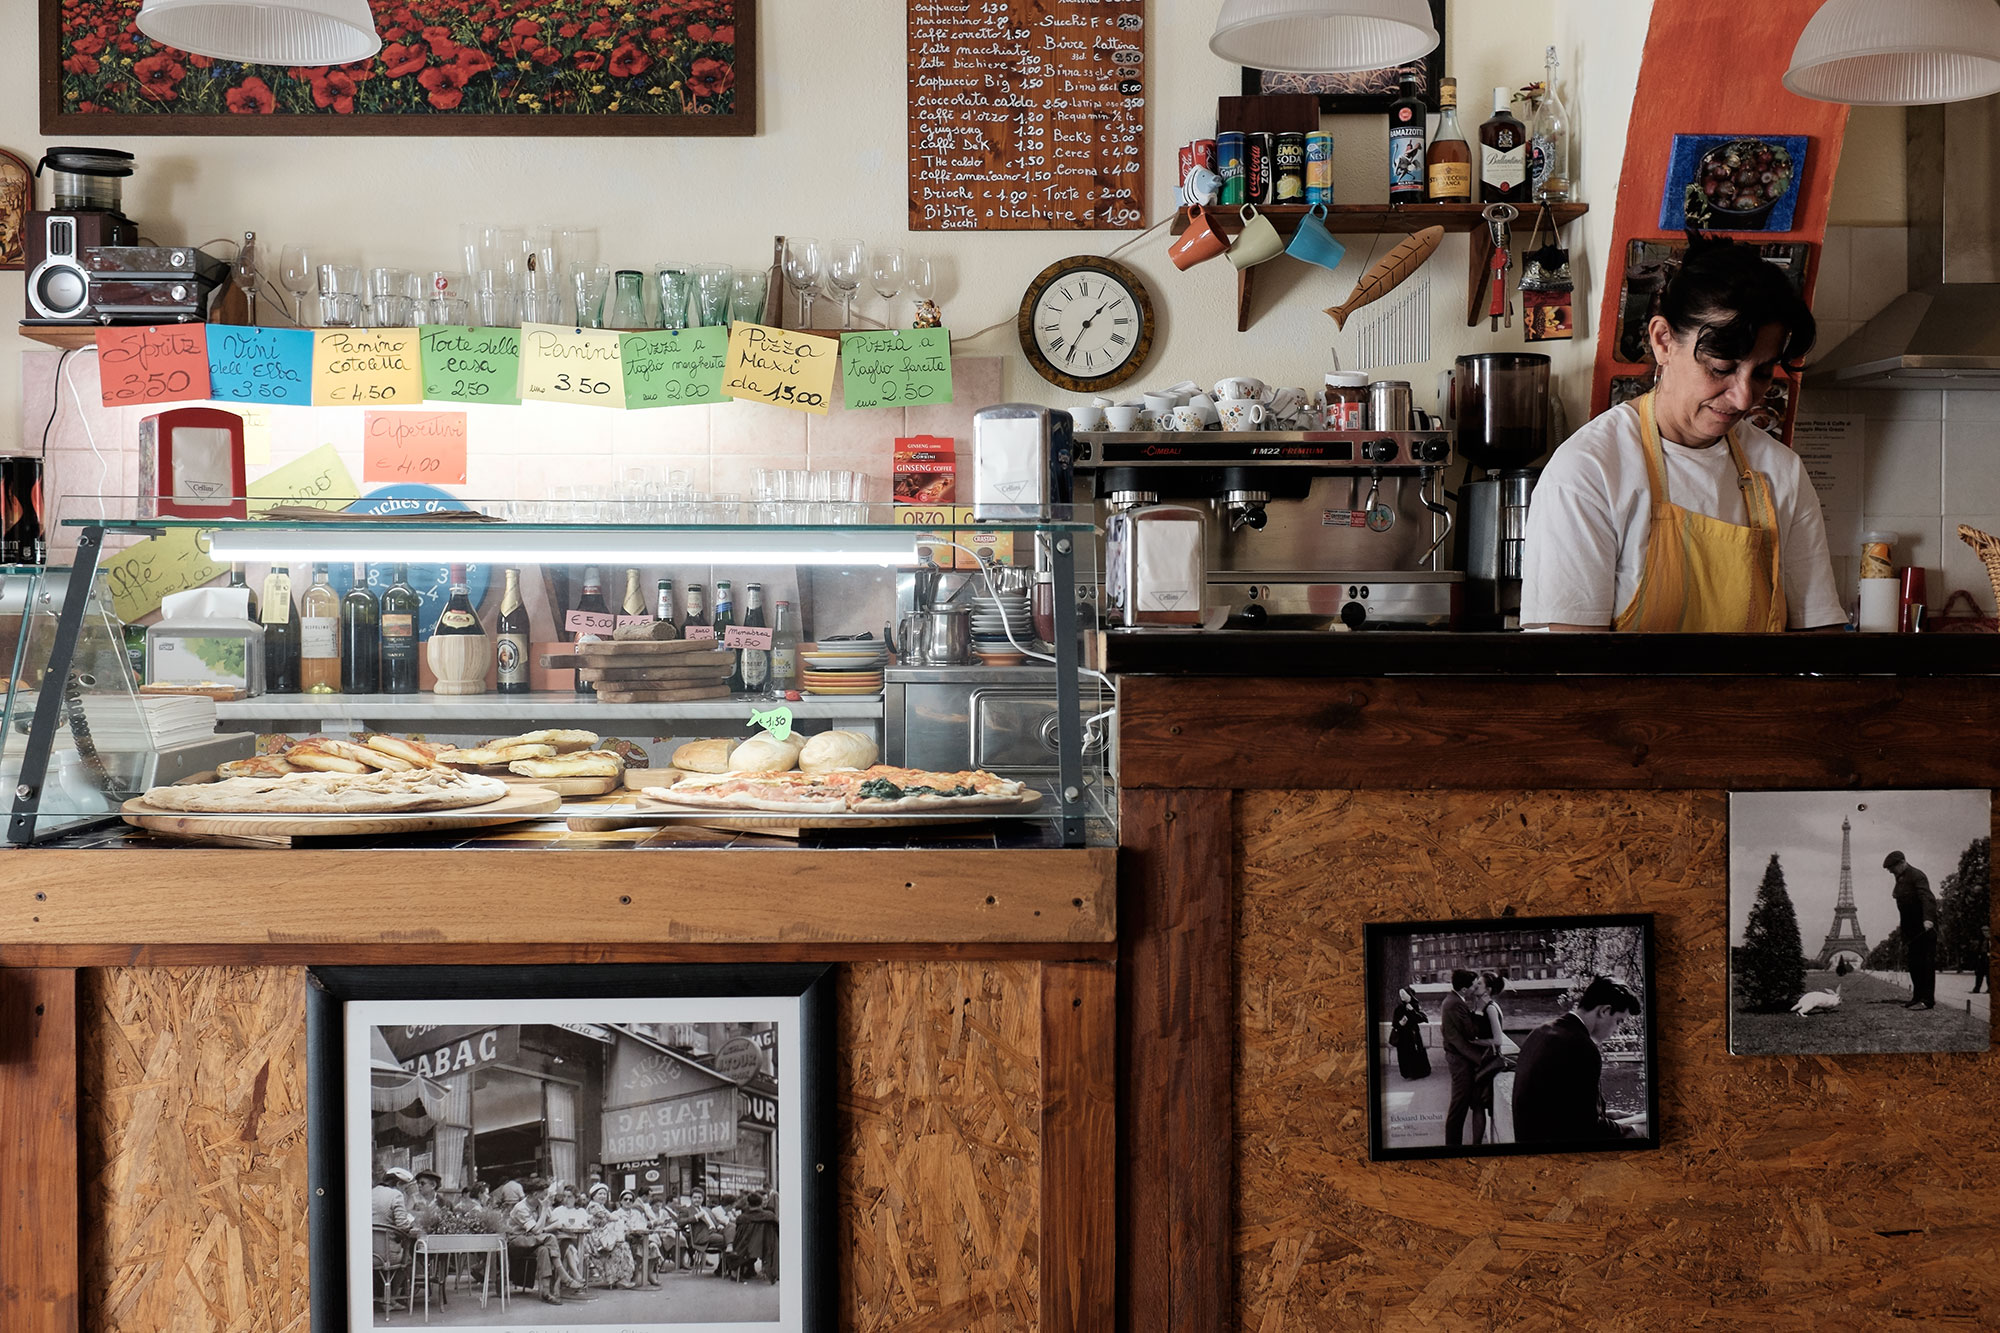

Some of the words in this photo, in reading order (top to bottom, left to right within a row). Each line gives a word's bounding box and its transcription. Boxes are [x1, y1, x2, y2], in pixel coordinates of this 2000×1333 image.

[915, 3, 970, 16] Cappuccio
[980, 2, 1008, 13] 1.30
[916, 15, 981, 25] Marocchino
[1040, 14, 1087, 27] Succhi
[914, 28, 948, 42] Caffè
[951, 28, 1001, 39] corretto
[1002, 29, 1030, 40] 1.50
[1043, 34, 1087, 51] Birre
[956, 43, 1029, 55] macchiato
[1094, 53, 1102, 61] €
[953, 57, 1008, 69] bicchiere
[916, 75, 979, 91] Cappuccio
[984, 74, 1010, 93] Big
[1121, 83, 1142, 93] 5.00
[915, 92, 989, 107] Cioccolata
[992, 93, 1038, 108] calda
[917, 108, 954, 124] Caffè
[961, 109, 1009, 121] d'orzo
[1013, 112, 1044, 124] 1.20
[1057, 111, 1087, 122] Acqua
[1014, 125, 1044, 137] 1.20
[1105, 123, 1111, 131] €
[919, 137, 955, 155] Caffè
[1014, 139, 1044, 152] 1.20
[1100, 134, 1106, 142] €
[1111, 134, 1135, 143] 3.00
[1055, 148, 1091, 158] Ceres
[1112, 145, 1138, 157] 4.00
[951, 157, 983, 167] caldo
[1015, 156, 1045, 168] 1.50
[1277, 155, 1303, 165] SODA
[1056, 164, 1098, 175] Corona
[1111, 161, 1140, 176] 4.00
[1261, 156, 1269, 184] zero
[919, 170, 952, 184] Caffè
[953, 171, 1021, 181] americano
[1021, 171, 1051, 183] 1.50
[923, 187, 974, 200] Brioche
[1043, 184, 1079, 200] Torte
[1087, 191, 1095, 200] €
[1100, 187, 1131, 198] 2.00
[986, 209, 994, 217] a
[1000, 204, 1076, 220] bicchiere
[1083, 209, 1094, 220] €
[223, 332, 281, 360] Vini
[420, 329, 473, 354] Torte
[527, 329, 620, 361] Panini
[624, 336, 681, 357] Pizza
[739, 328, 825, 358] Pizza
[845, 334, 912, 354] Pizza
[918, 337, 935, 348] a
[102, 332, 203, 370] Spritz
[440, 358, 497, 374] casa
[739, 350, 800, 375] Maxi
[848, 357, 894, 384] taglio
[899, 355, 946, 381] farcita
[116, 370, 191, 403] 3,50
[211, 387, 225, 397] €
[232, 380, 287, 398] 3.50
[330, 386, 346, 399] €
[352, 383, 396, 401] 4.50
[427, 384, 441, 394] €
[554, 373, 611, 395] 3.50
[665, 379, 710, 400] 2.00
[727, 377, 762, 393] da
[882, 380, 935, 402] 2.50
[1281, 447, 1324, 455] PREMIUM
[397, 456, 440, 473] 4.00
[896, 464, 931, 472] GINSENG
[367, 569, 380, 587] 8
[437, 568, 449, 585] 3
[426, 585, 439, 601] 4
[571, 615, 581, 625] €
[585, 616, 613, 628] 5.00
[400, 1030, 497, 1078] TABAC
